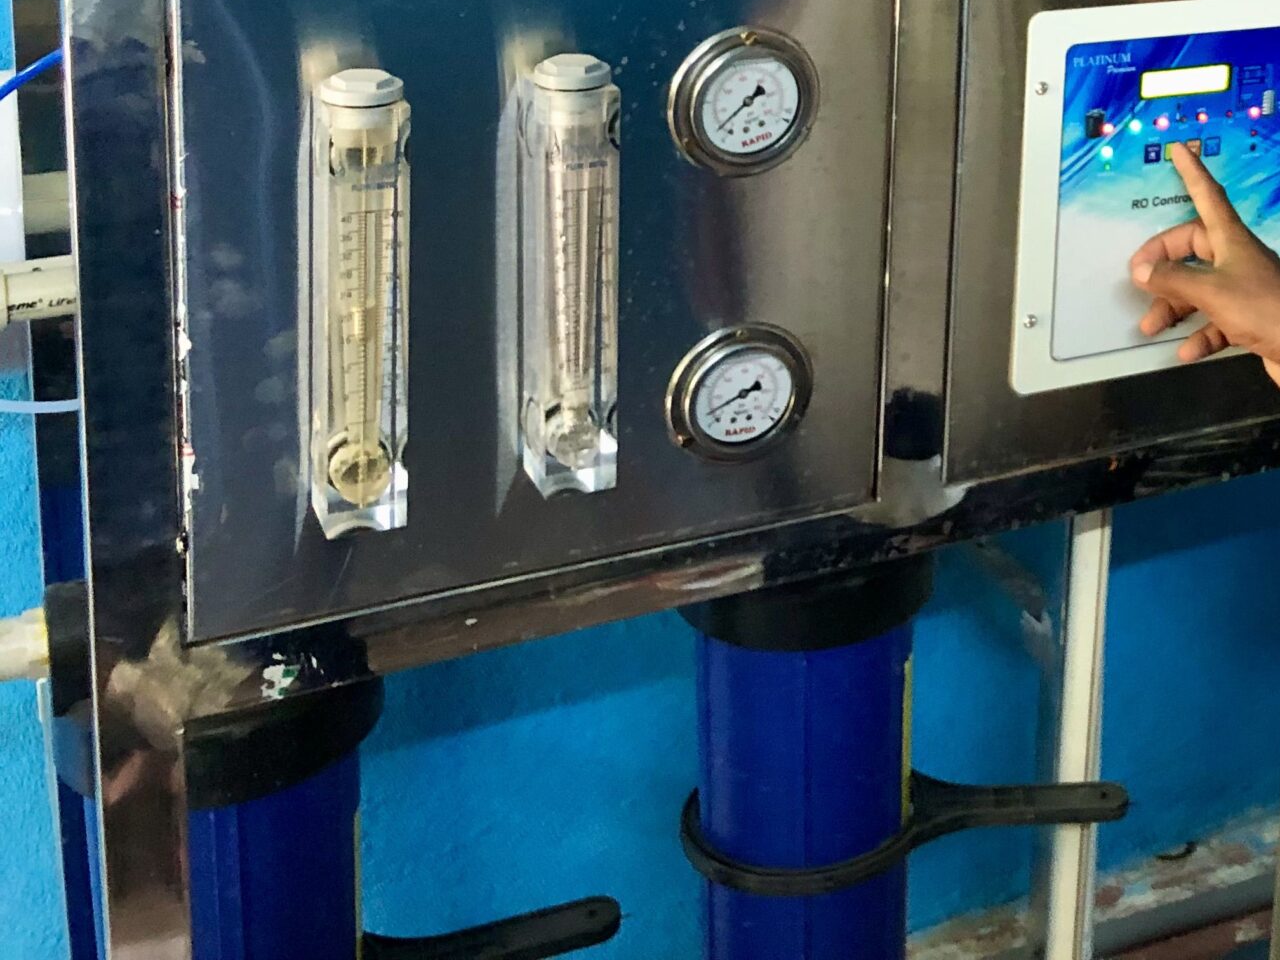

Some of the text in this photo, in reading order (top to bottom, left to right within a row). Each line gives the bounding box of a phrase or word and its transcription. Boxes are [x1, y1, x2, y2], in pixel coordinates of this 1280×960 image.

[1073, 52, 1131, 68] PLATINUM
[741, 131, 772, 148] RAPID
[1131, 194, 1192, 210] RO Contro
[725, 426, 756, 436] RAPID
